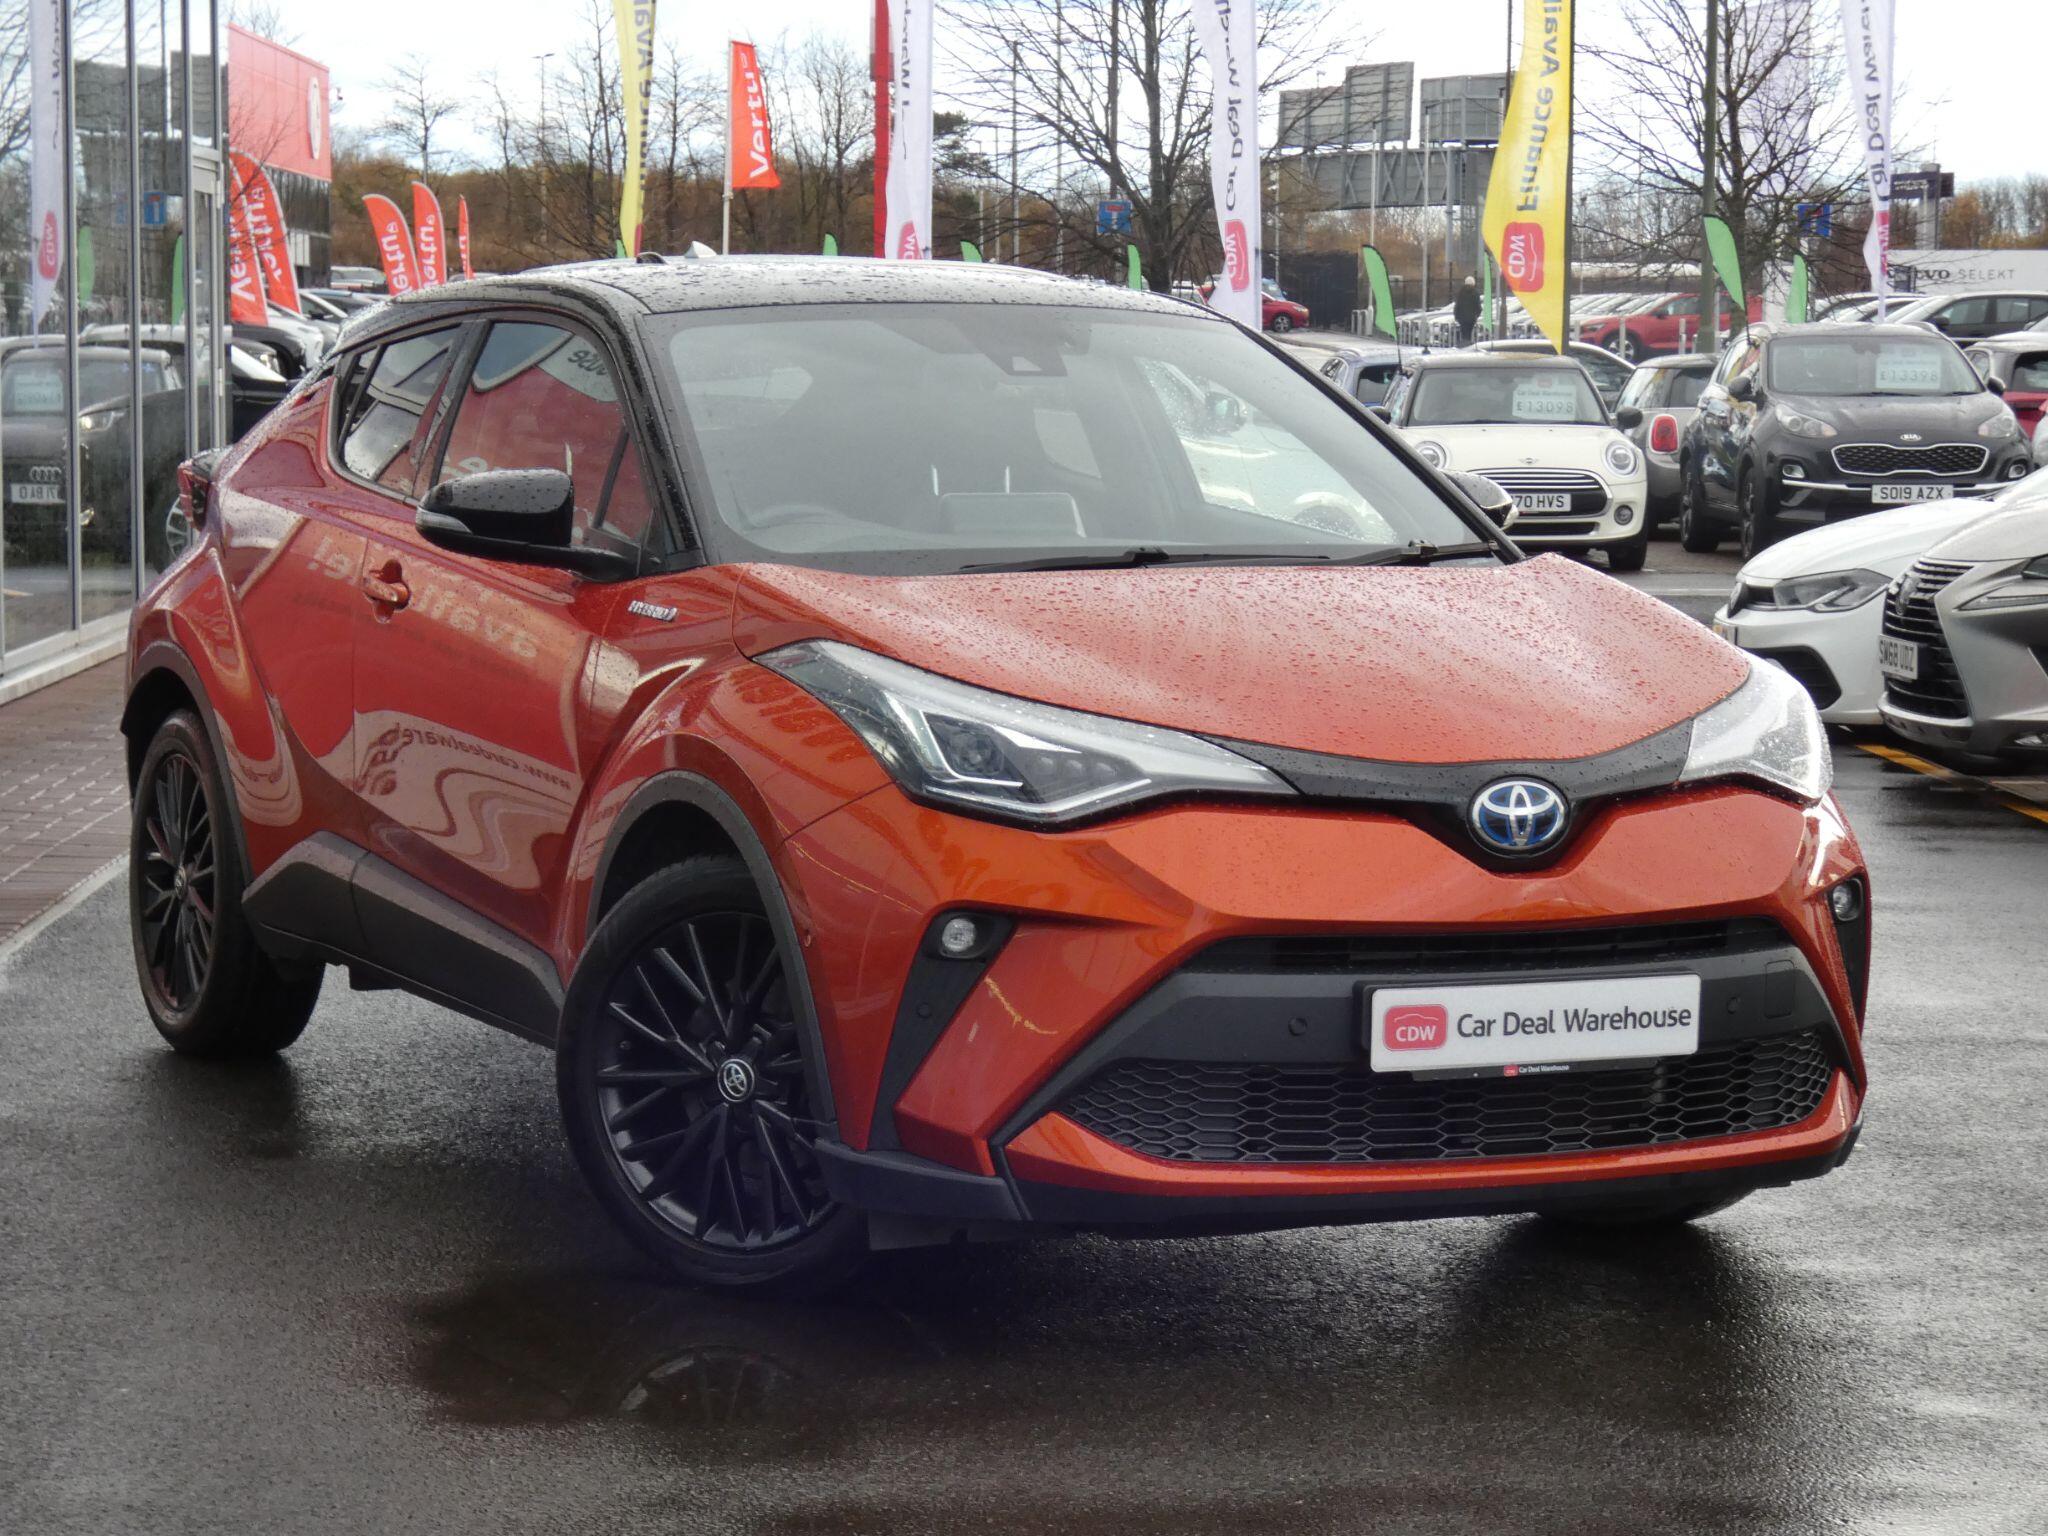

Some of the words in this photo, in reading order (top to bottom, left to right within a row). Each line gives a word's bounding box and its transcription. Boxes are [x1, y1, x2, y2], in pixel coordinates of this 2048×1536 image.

[744, 70, 770, 178] Vertu
[1958, 269, 2015, 281] SELEKT
[1880, 486, 1912, 500] SO19
[1916, 486, 1944, 499] AZX
[1511, 495, 1533, 508] 70
[1536, 495, 1565, 508] HVS
[1456, 1013, 1497, 1038] Car
[1502, 1010, 1556, 1036] Deal
[1562, 1005, 1692, 1034] Warehouse
[1395, 1025, 1437, 1042] CDW
